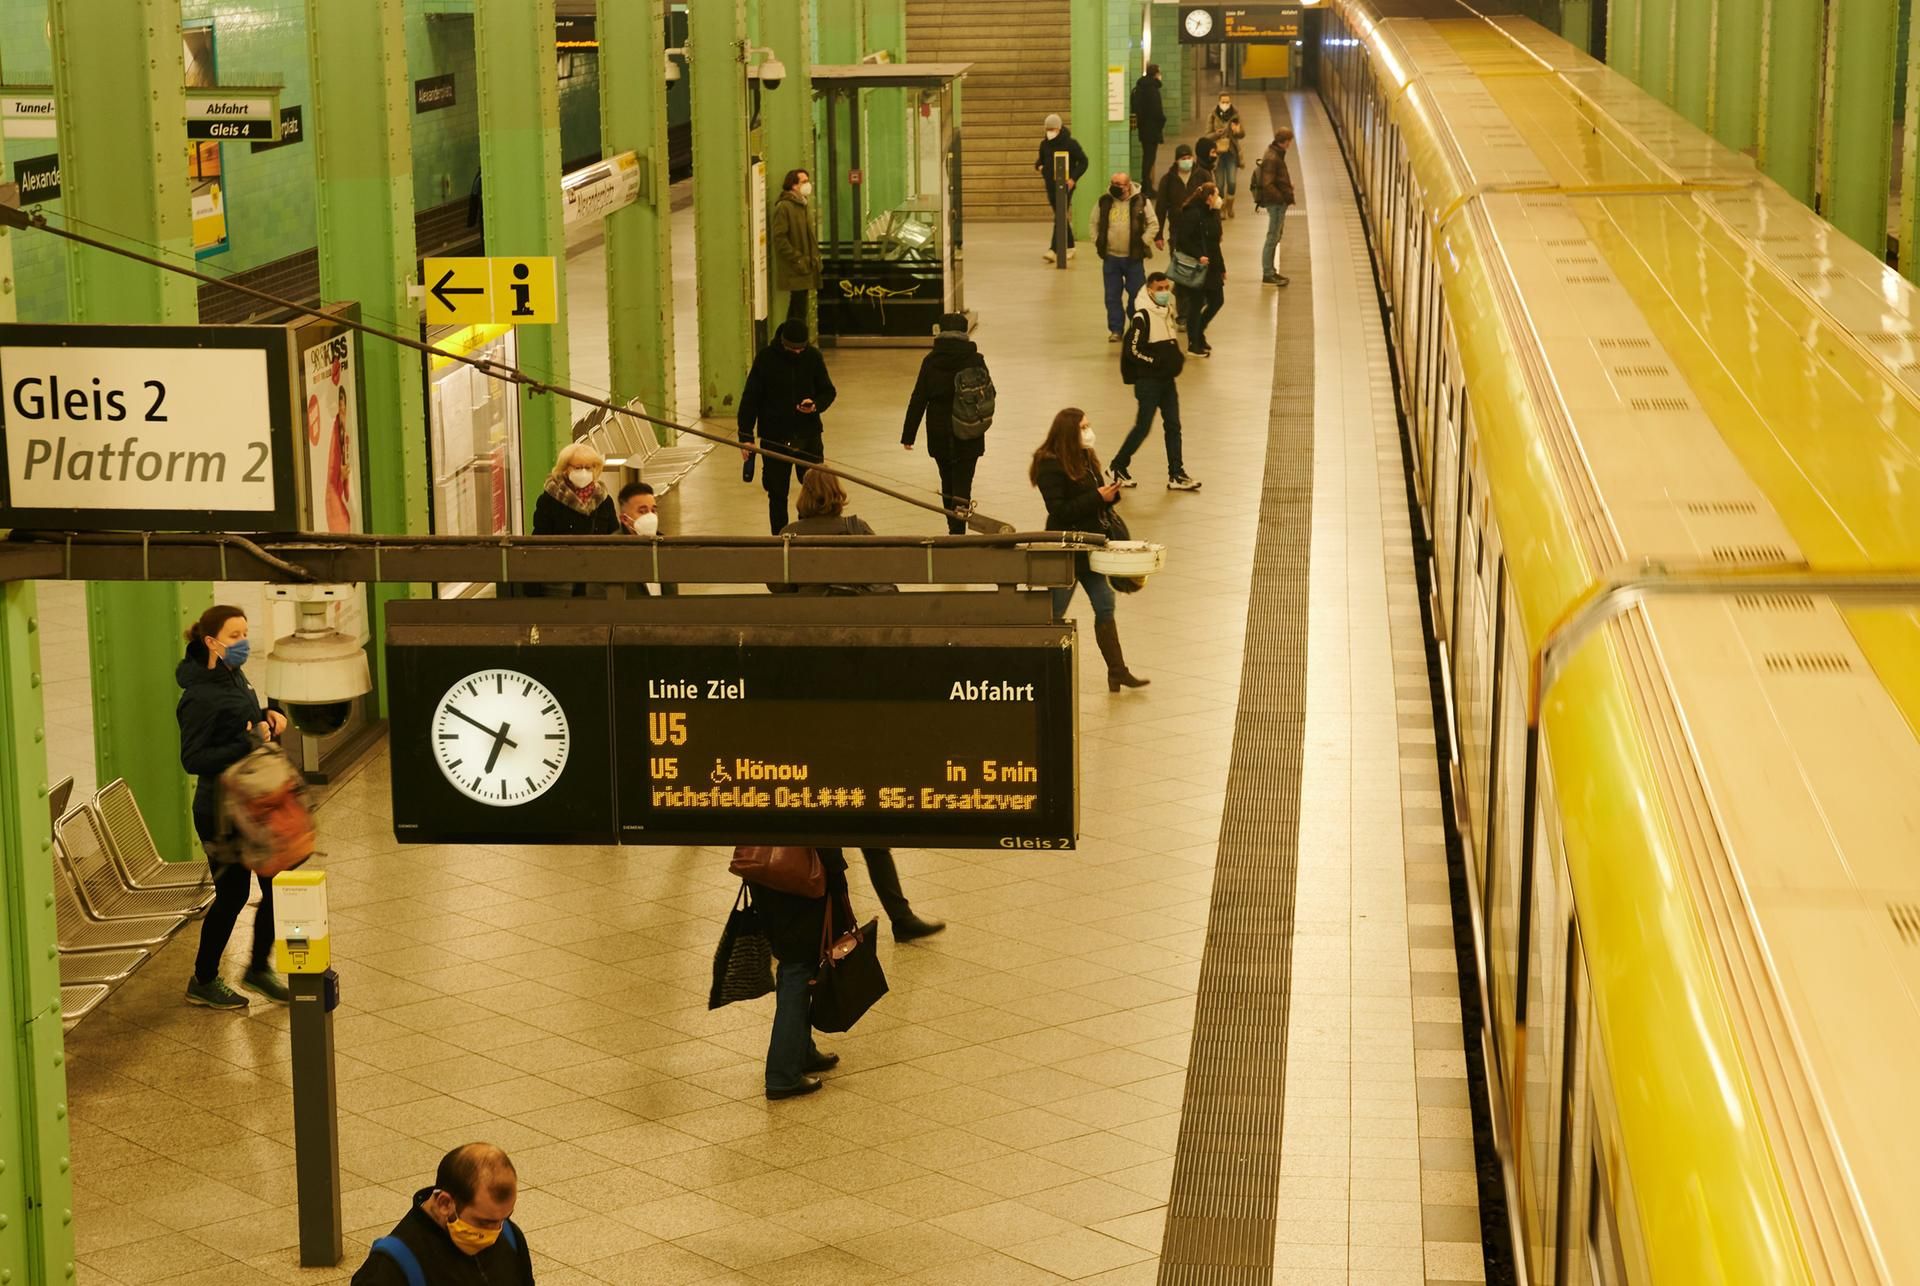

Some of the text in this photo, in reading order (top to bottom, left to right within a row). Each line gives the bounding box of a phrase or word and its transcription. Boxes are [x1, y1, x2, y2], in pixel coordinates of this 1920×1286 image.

[15, 102, 55, 113] Tunnel-
[206, 103, 248, 114] Abfahrt
[209, 123, 250, 136] Gleis 4
[13, 375, 168, 422] Gleis 2
[23, 436, 270, 483] Platform 2
[649, 678, 1034, 701] Linie Ziel Abfahrt
[650, 712, 687, 746] U5
[651, 758, 1038, 782] U5 Hönow in 5 min
[879, 787, 915, 809] S5:
[921, 788, 1037, 810] Ersatzver
[1000, 836, 1071, 849] Gleis 2
